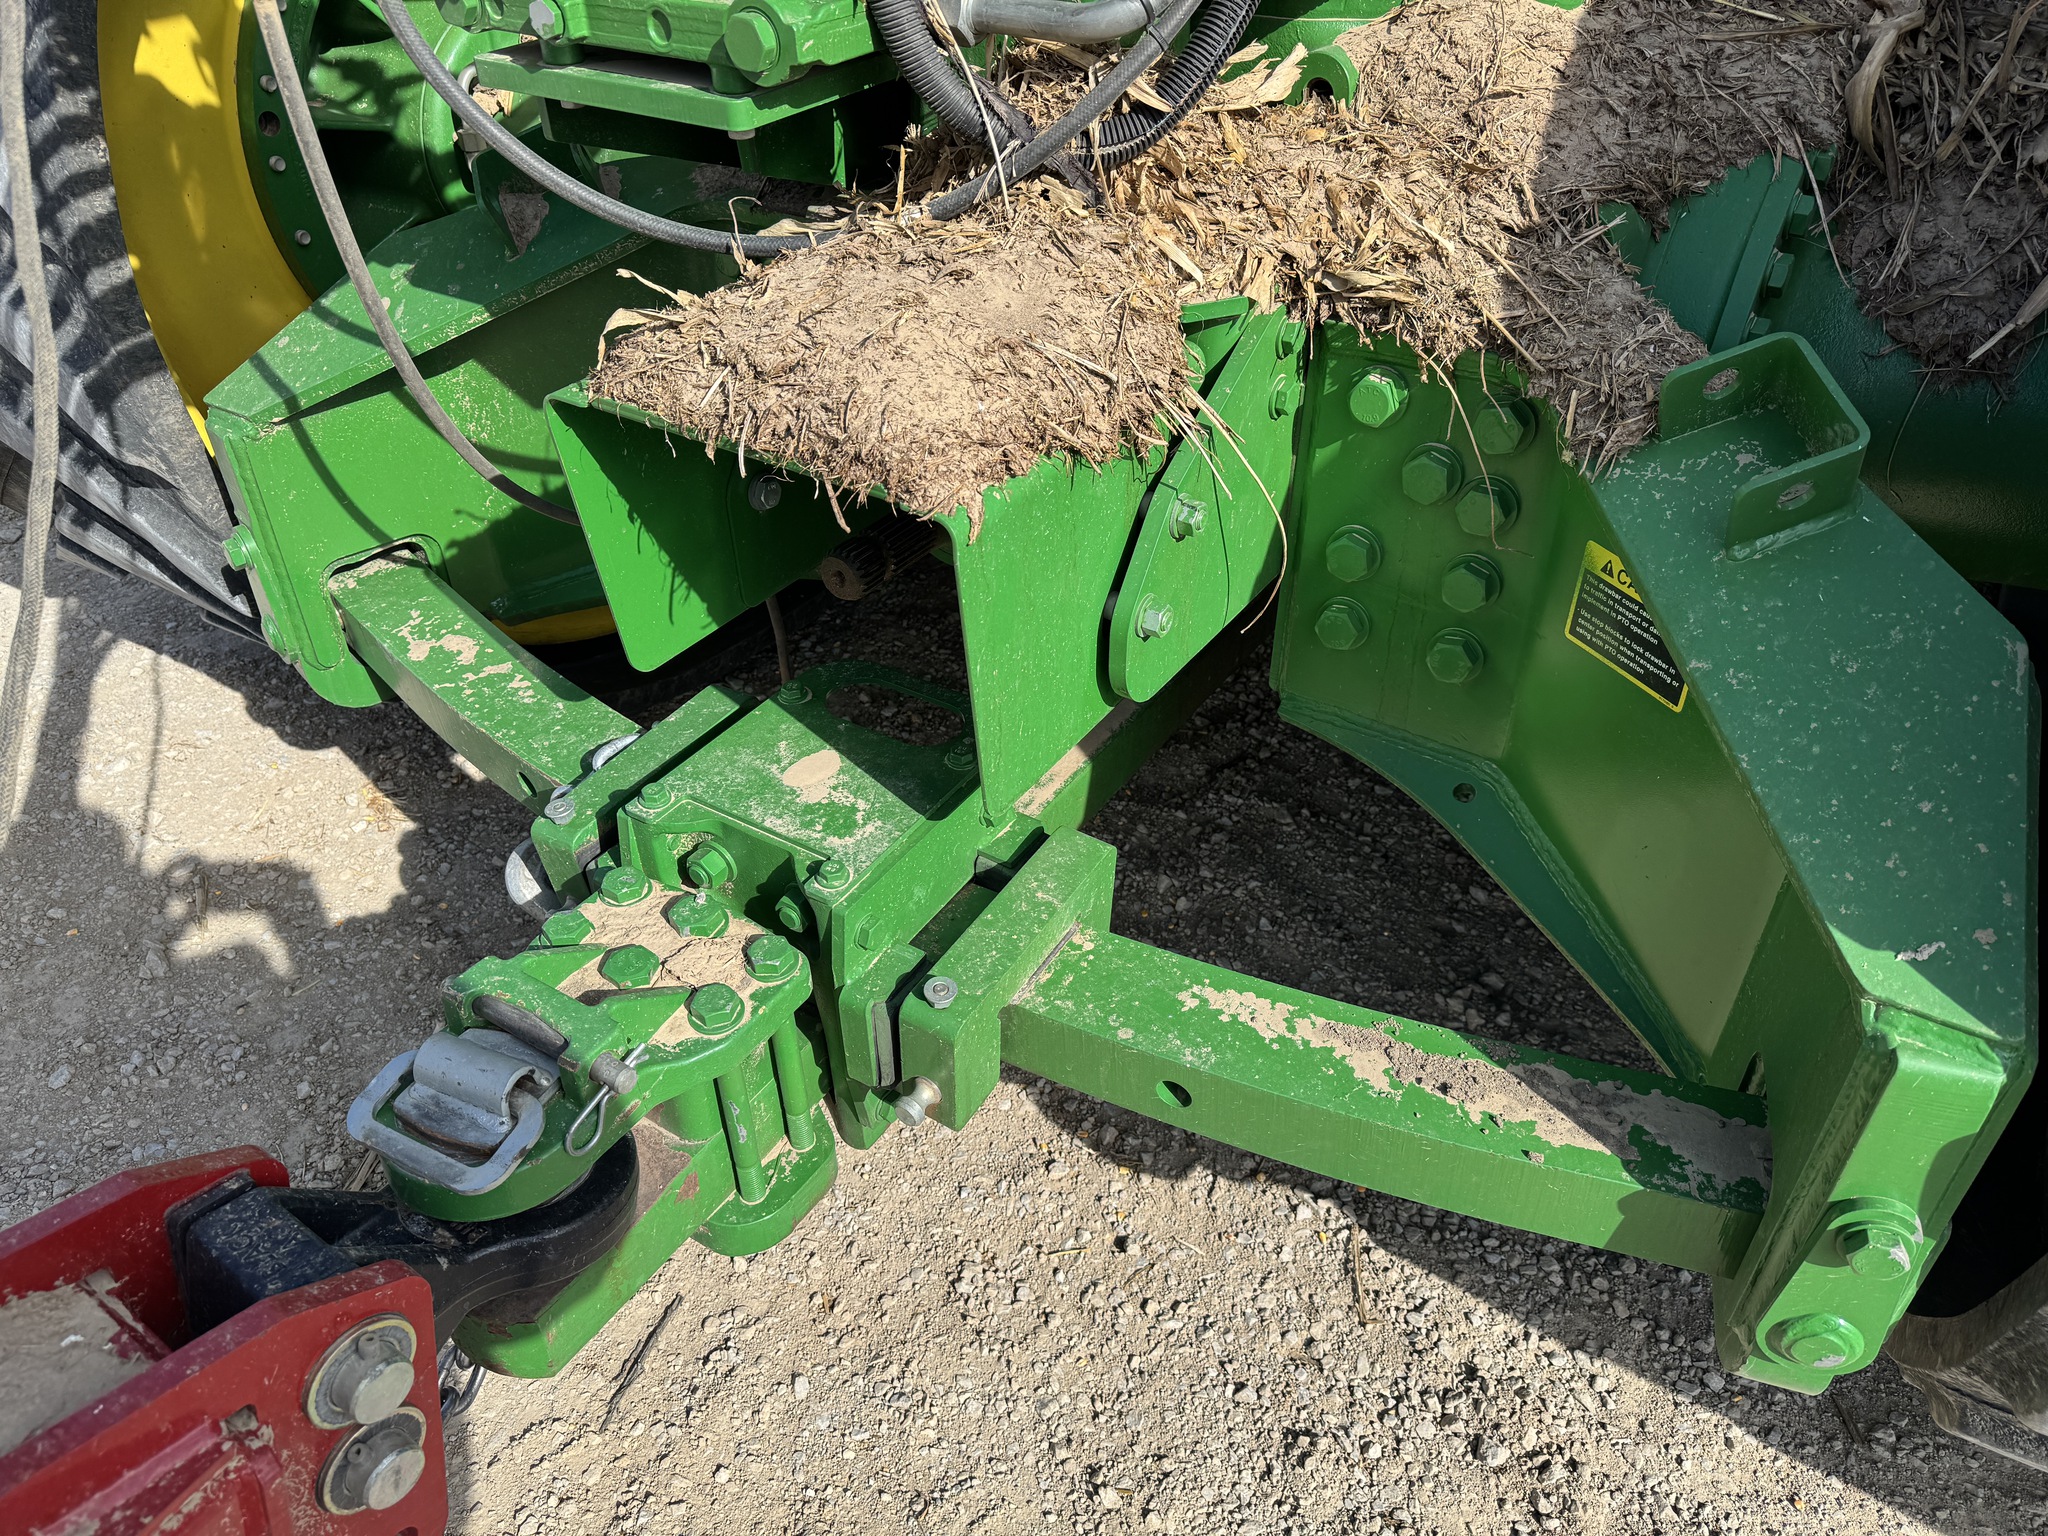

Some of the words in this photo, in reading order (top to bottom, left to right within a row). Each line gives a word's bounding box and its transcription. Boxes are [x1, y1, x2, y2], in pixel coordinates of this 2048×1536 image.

[1584, 583, 1590, 591] to
[1591, 587, 1607, 602] traffic
[1608, 598, 1614, 606] in
[1614, 602, 1641, 626] transport
[1642, 621, 1649, 629] or
[1587, 574, 1598, 586] This
[1599, 582, 1621, 601] drawbar
[1622, 596, 1638, 612] could
[1617, 569, 1638, 593] CA
[1581, 608, 1591, 619] Use
[1592, 616, 1604, 629] stop
[1605, 624, 1623, 641] blocks
[1625, 637, 1631, 645] to
[1632, 641, 1644, 653] lock
[1645, 650, 1669, 670] drawbar
[1670, 667, 1676, 675] in
[1582, 591, 1610, 615] implement
[1611, 610, 1616, 618] in
[1617, 614, 1629, 626] PTO
[1630, 622, 1658, 647] operation
[1576, 625, 1591, 640] using
[1592, 635, 1604, 647] with
[1605, 644, 1616, 656] PTO
[1617, 652, 1644, 676] operation
[1578, 617, 1595, 632] center
[1596, 628, 1619, 649] position
[1620, 644, 1635, 658] when
[1635, 654, 1672, 684] transporting
[1672, 680, 1679, 688] or
